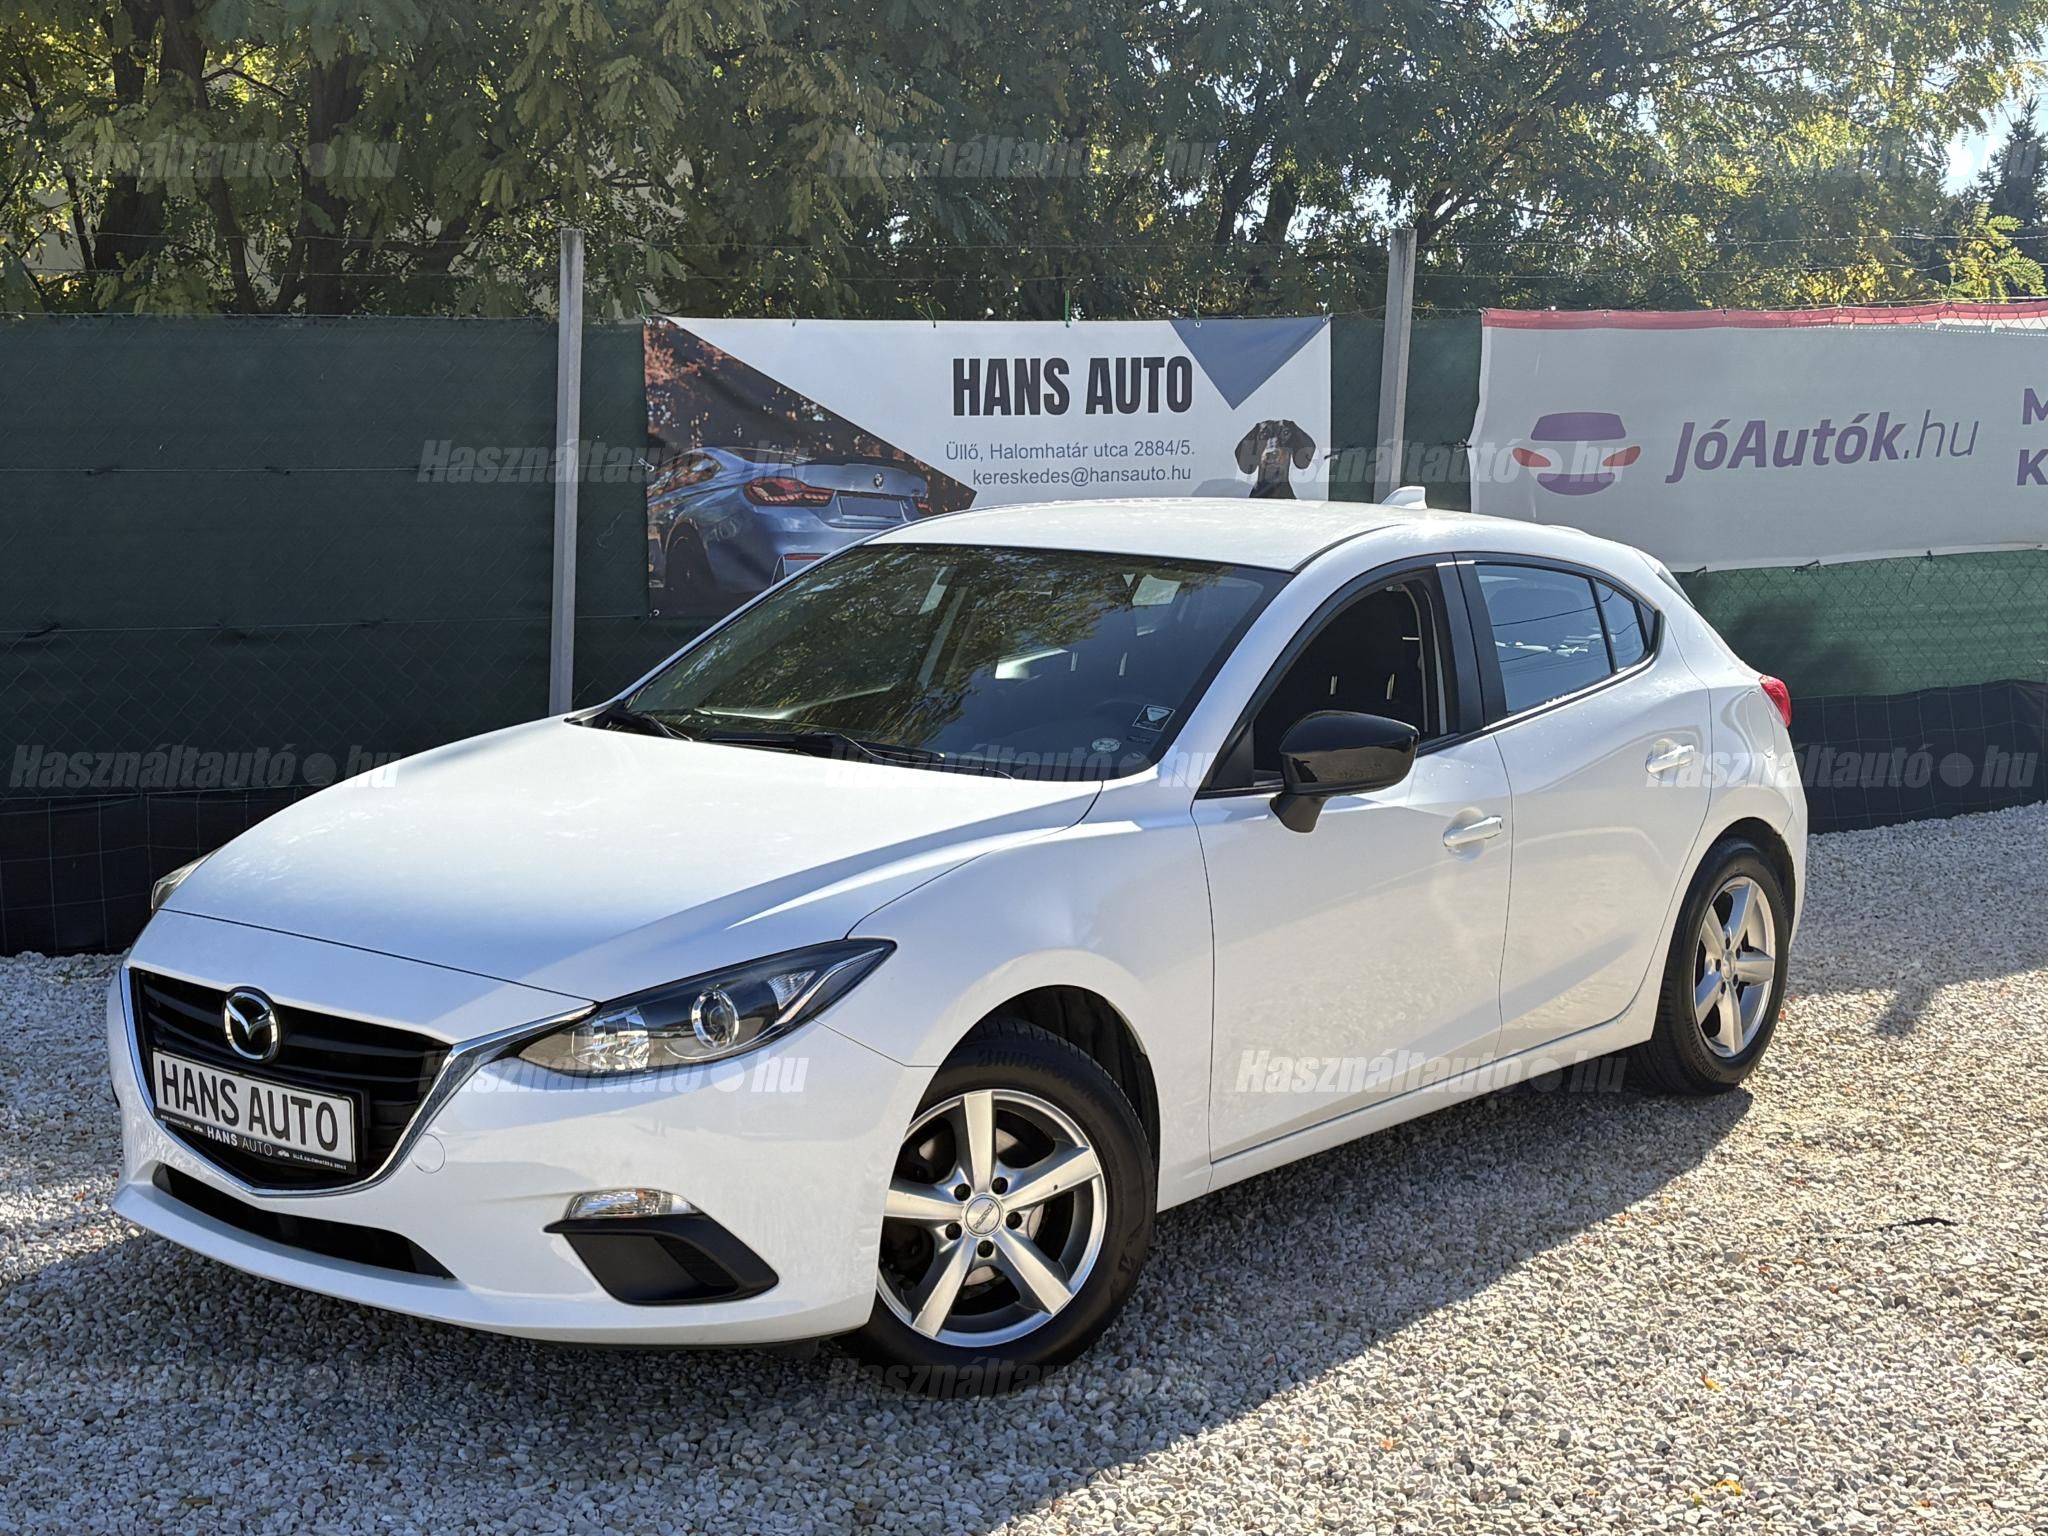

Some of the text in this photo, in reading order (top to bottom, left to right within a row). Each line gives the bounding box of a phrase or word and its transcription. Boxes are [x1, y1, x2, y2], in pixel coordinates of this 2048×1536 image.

[953, 355, 1193, 416] HANS AUTO
[945, 439, 1195, 463] Üllő, Halomhatár utca 2884/5.
[1665, 409, 1979, 484] JóAutók.hu
[972, 465, 1191, 487] kereskedes@hansauto.hu
[160, 1060, 338, 1151] HANS AUTO
[206, 1125, 273, 1157] HANS AUTO
